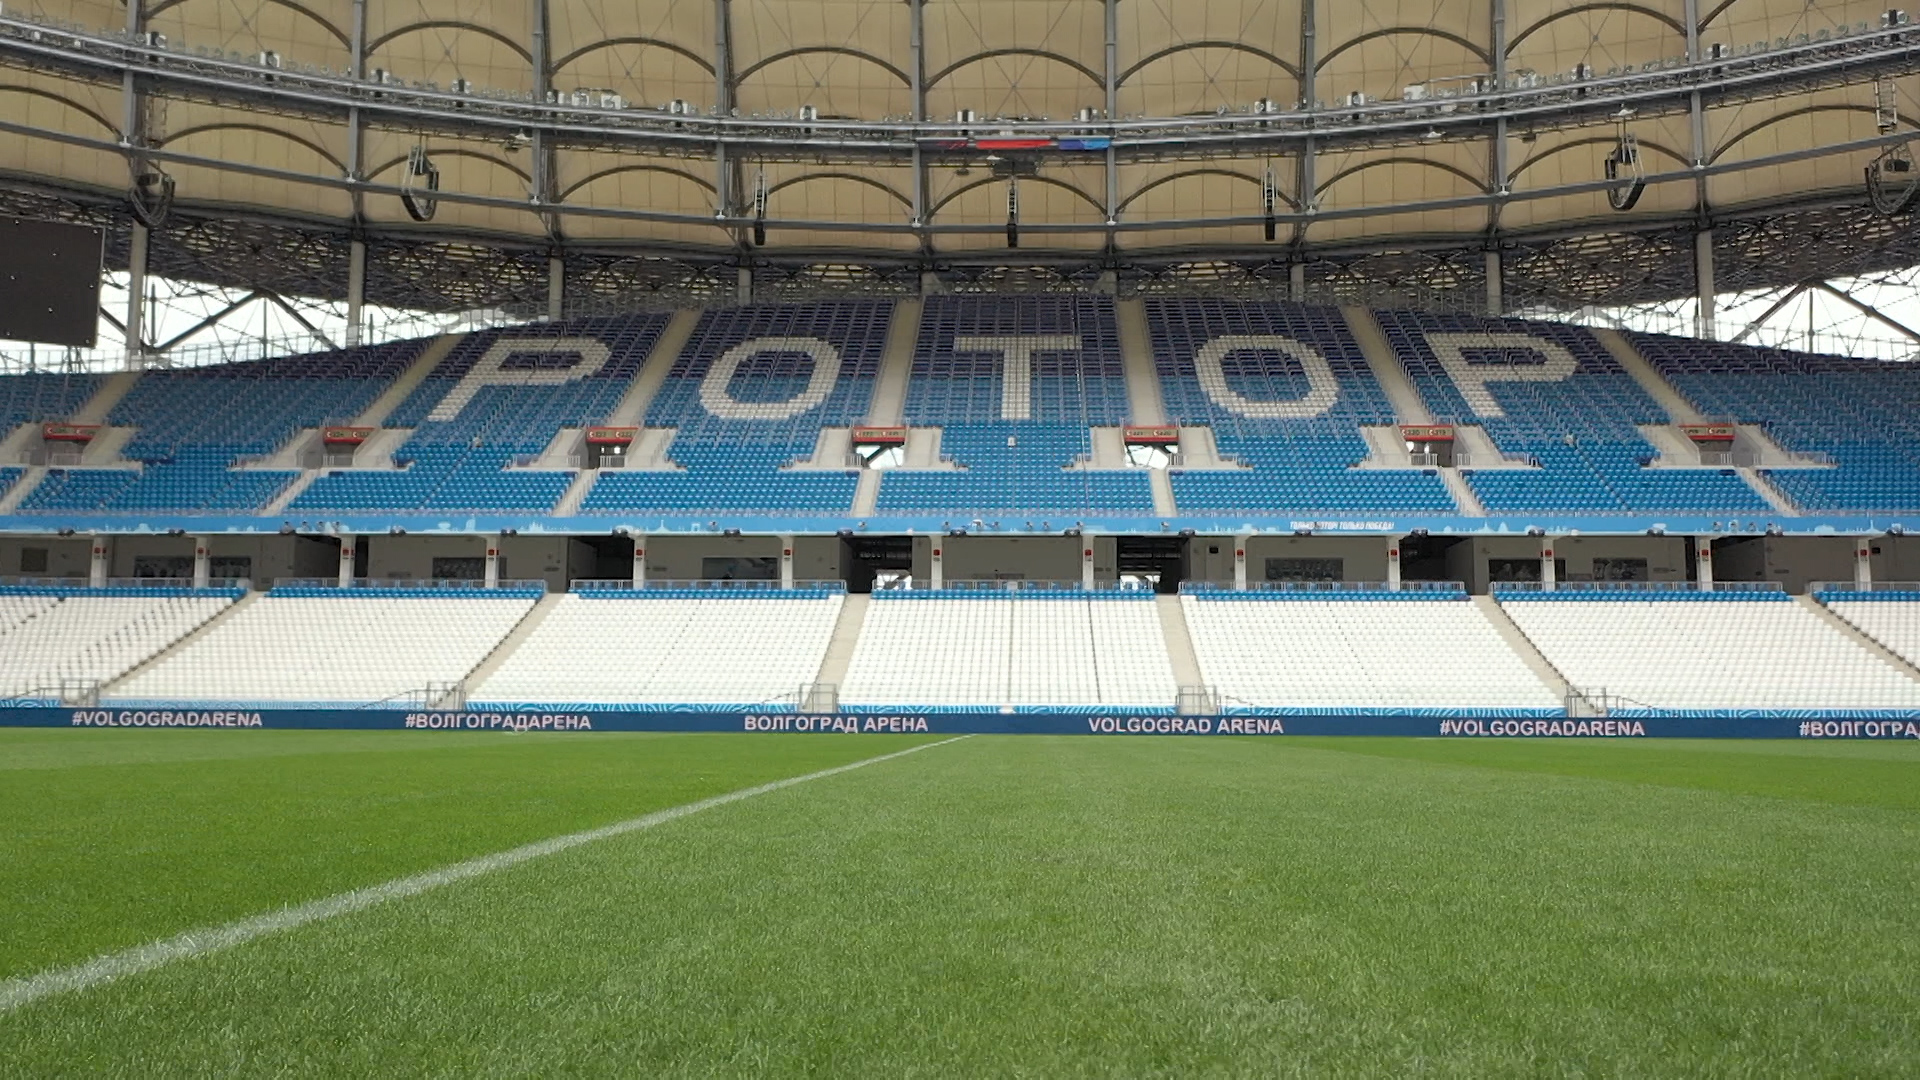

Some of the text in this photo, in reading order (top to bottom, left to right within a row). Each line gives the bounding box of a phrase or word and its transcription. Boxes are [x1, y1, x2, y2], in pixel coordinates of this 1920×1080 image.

[427, 332, 1578, 421] РОТОР
[71, 711, 262, 726] #VOLGOGRADARENA
[404, 713, 592, 730] #ВОЛГОГРАДАРЕНА
[744, 715, 928, 732] ВОЛГОГРАД АРЕНА
[1088, 717, 1284, 733] VOLGOGRAD ARENA
[1439, 720, 1646, 736] #VOLGOGRADARENA
[1799, 721, 1920, 738] #ВОЛГОГРА
